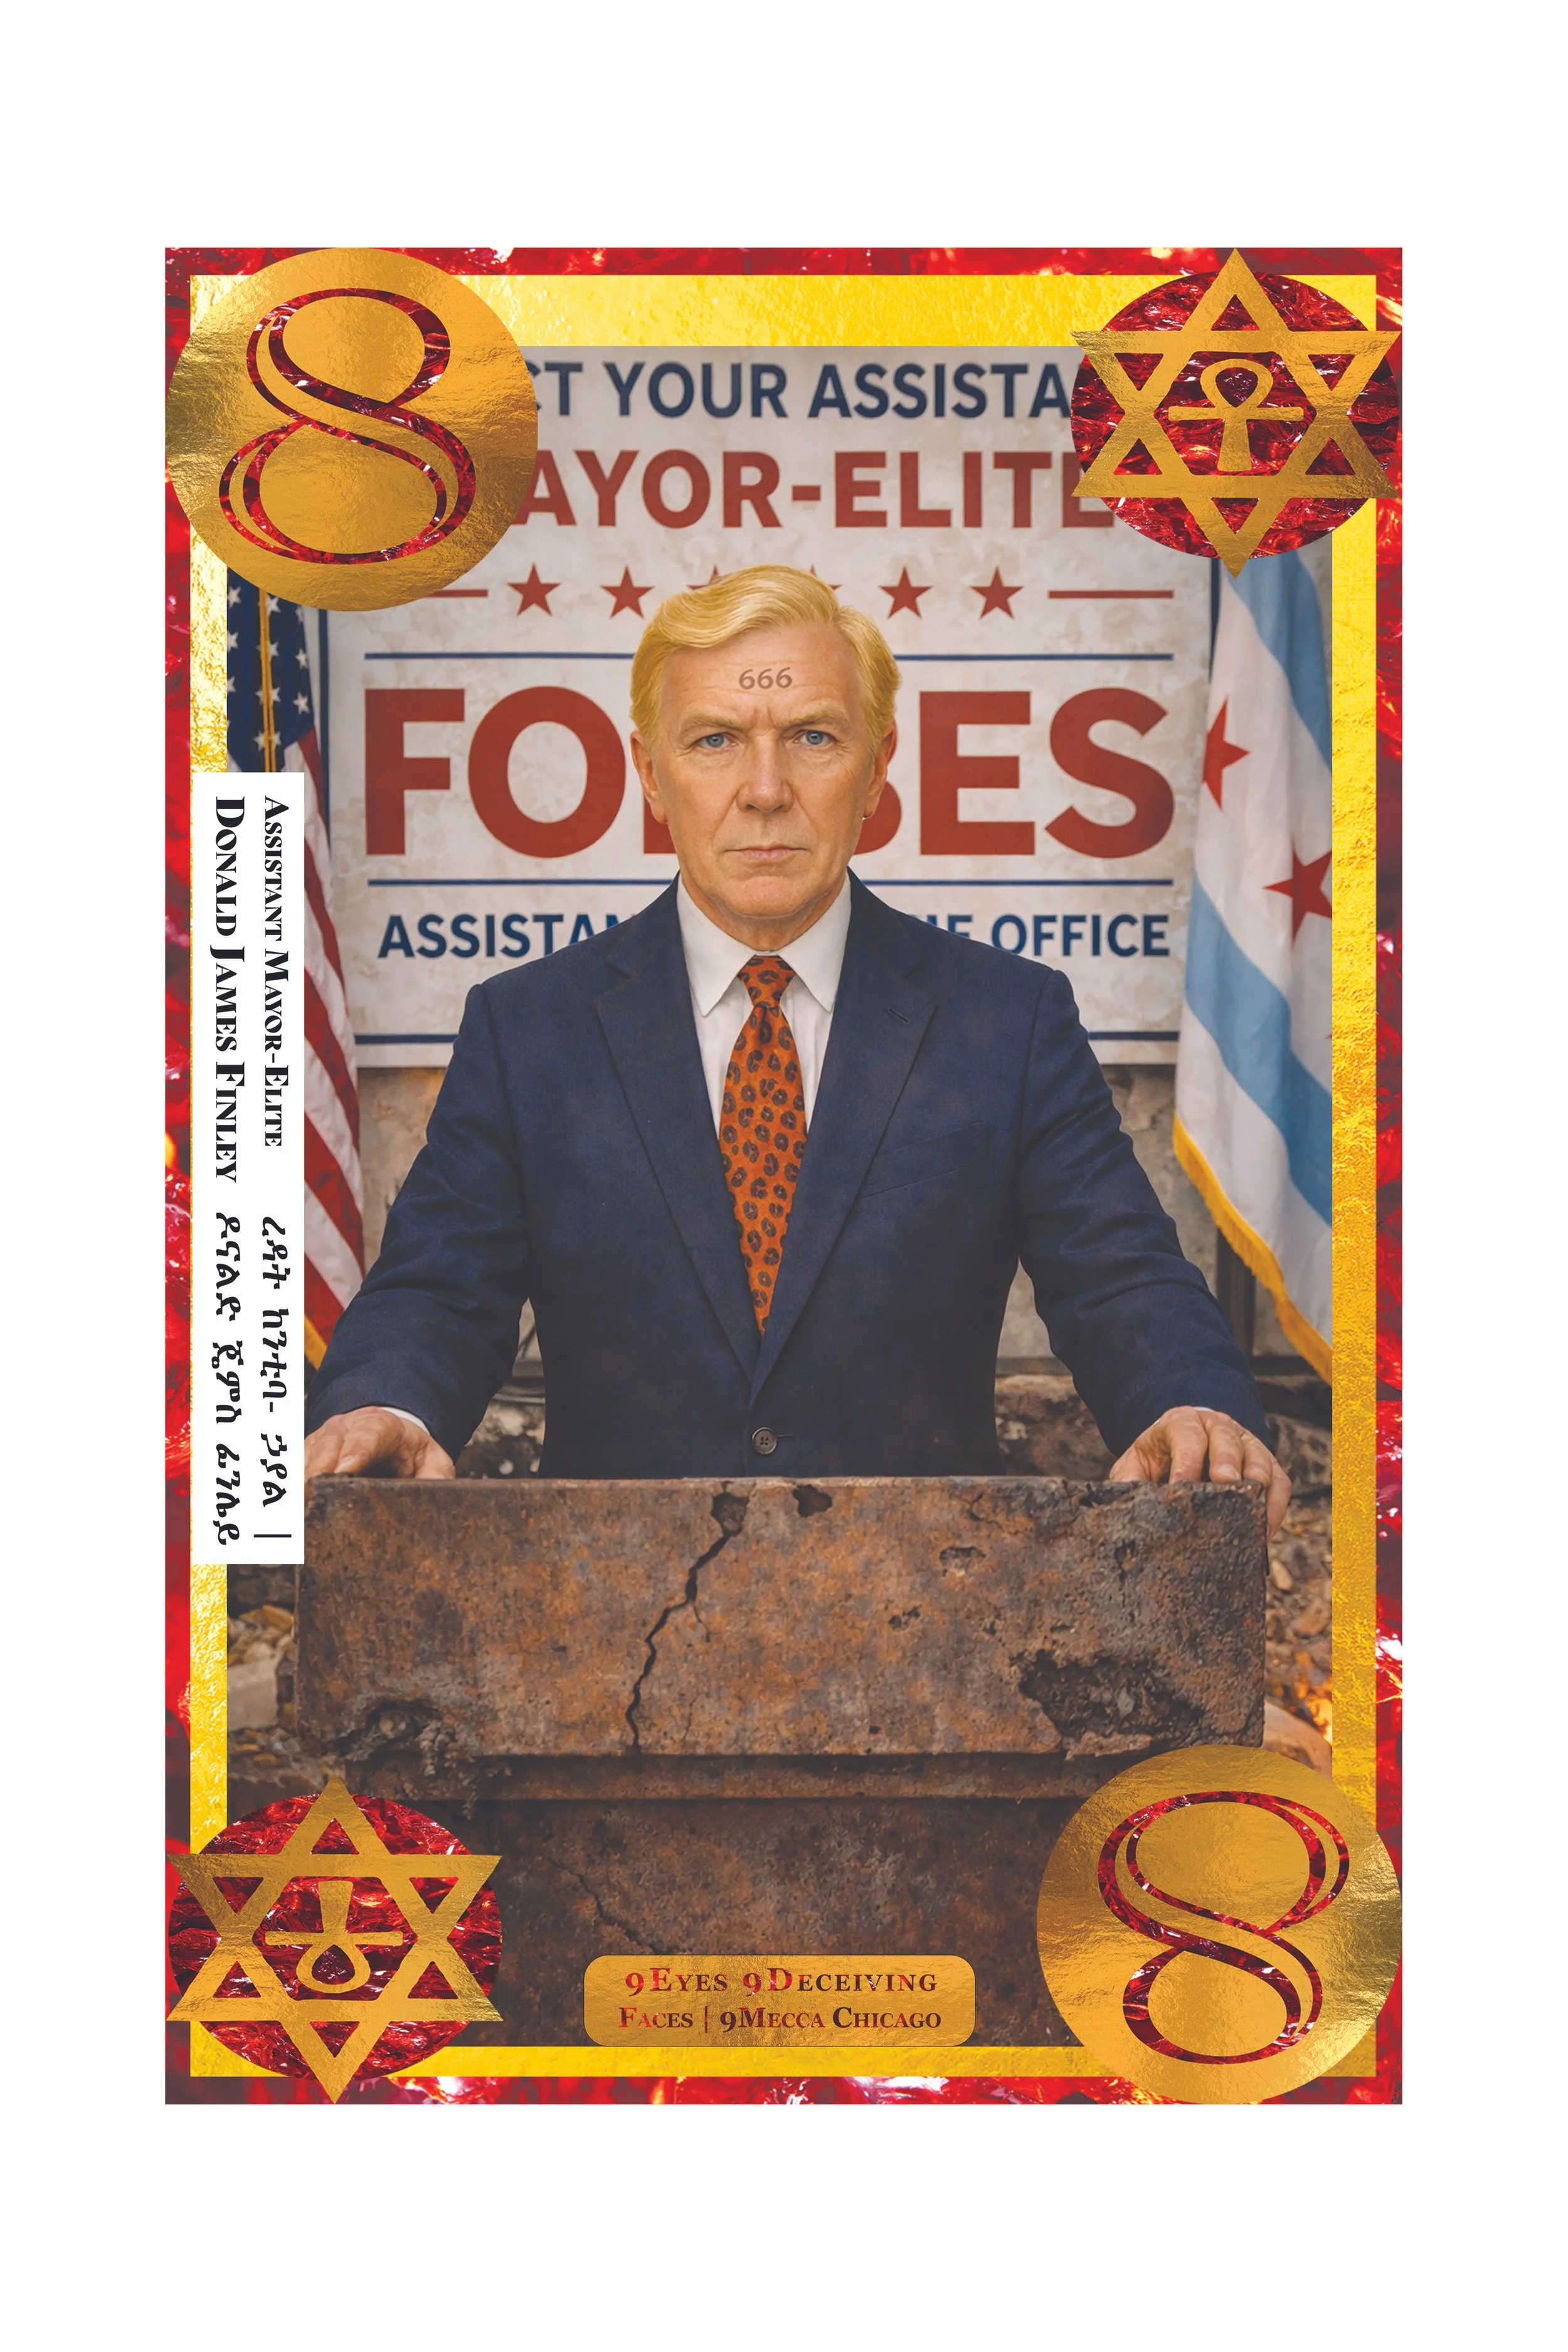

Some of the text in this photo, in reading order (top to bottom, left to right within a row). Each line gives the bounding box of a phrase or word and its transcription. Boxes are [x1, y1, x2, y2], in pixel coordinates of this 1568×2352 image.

[602, 361, 788, 418] YOUR
[739, 666, 793, 690] 666
[364, 686, 1175, 859] FOES
[991, 913, 1170, 956] OFFICE
